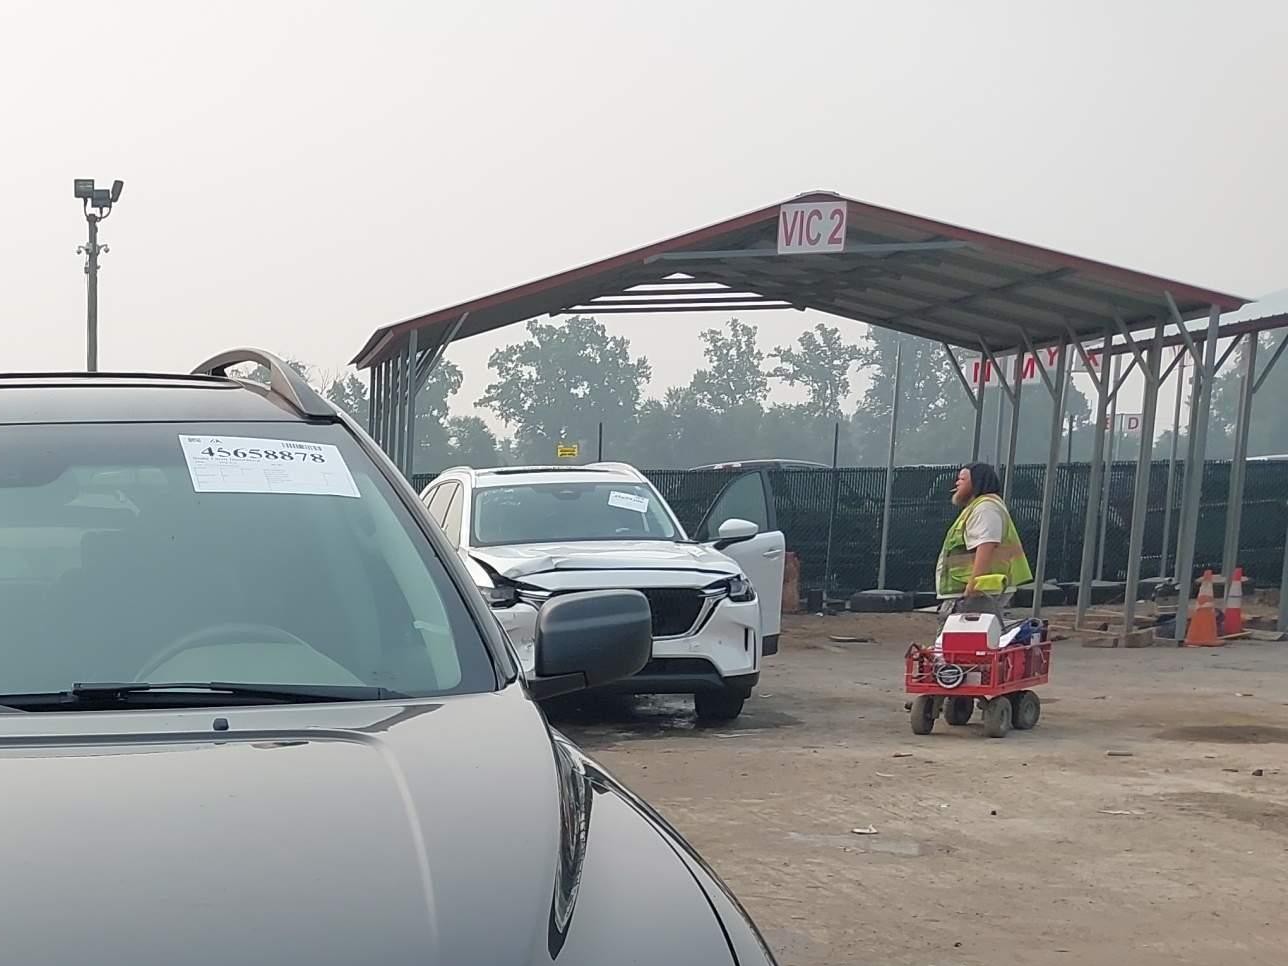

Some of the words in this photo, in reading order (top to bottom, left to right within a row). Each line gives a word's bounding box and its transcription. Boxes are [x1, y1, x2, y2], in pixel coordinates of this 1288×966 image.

[782, 209, 822, 247] VIC
[827, 208, 844, 245] 2
[1128, 417, 1139, 430] D
[201, 446, 326, 463] 45658878
